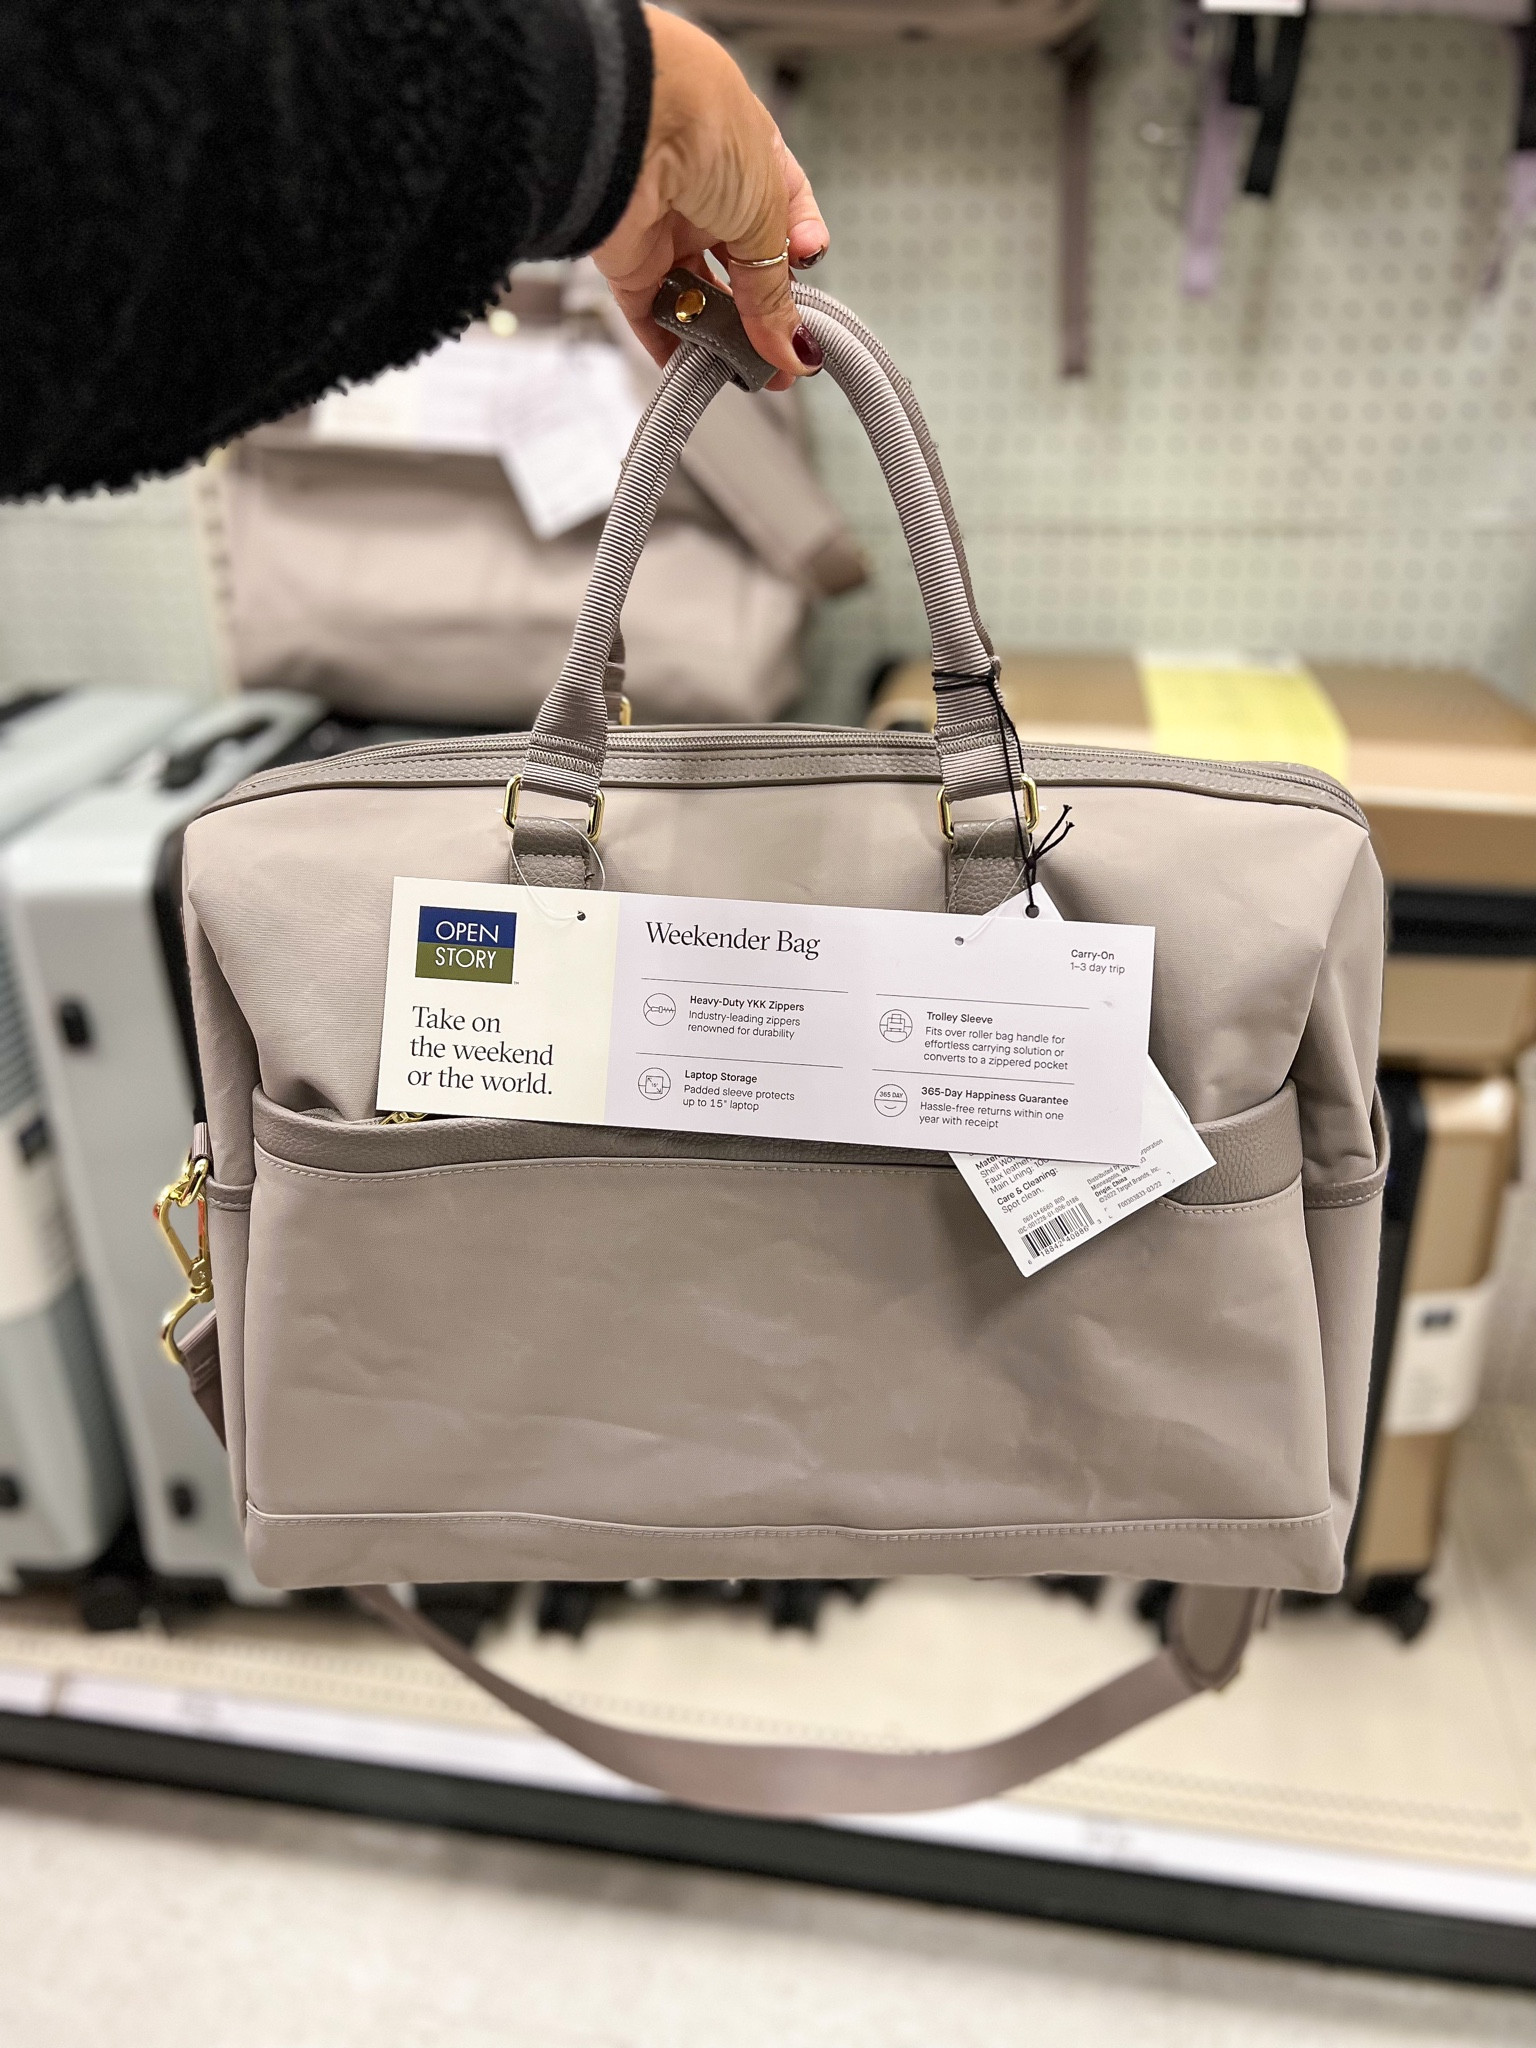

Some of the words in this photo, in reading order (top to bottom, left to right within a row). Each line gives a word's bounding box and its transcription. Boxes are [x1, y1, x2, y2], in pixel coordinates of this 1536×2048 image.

[435, 920, 499, 944] OPEN
[645, 921, 771, 951] Weekender
[775, 930, 821, 961] Bag
[435, 946, 497, 970] STORY
[1070, 949, 1115, 962] Carry-On
[1088, 963, 1107, 975] day
[1109, 964, 1126, 976] trip
[689, 995, 745, 1010] Heavy-Duty
[746, 999, 767, 1009] YKK
[768, 1000, 805, 1013] Zippers
[412, 1005, 466, 1031] Take
[471, 1016, 501, 1034] on
[688, 1010, 764, 1027] Industry-leading
[765, 1016, 801, 1028] zippers
[926, 1011, 959, 1024] Trolley
[960, 1013, 993, 1025] Sleeve
[687, 1023, 735, 1035] renowned
[737, 1025, 751, 1036] for
[752, 1027, 795, 1041] durability
[925, 1026, 943, 1036] Fits
[944, 1029, 967, 1038] over
[968, 1029, 993, 1040] roller
[995, 1030, 1014, 1044] bag
[1016, 1032, 1049, 1044] handle
[1051, 1034, 1066, 1045] for
[409, 1035, 446, 1059] the
[452, 1040, 553, 1066] weekend
[924, 1039, 970, 1051] effortless
[971, 1043, 1011, 1056] carrying
[1013, 1045, 1052, 1057] solution
[1054, 1049, 1065, 1057] or
[923, 1053, 966, 1064] converts
[968, 1055, 979, 1064] to
[980, 1057, 986, 1065] a
[988, 1056, 1032, 1068] zippered
[1033, 1060, 1069, 1070] pocket
[407, 1070, 433, 1086] or
[437, 1066, 474, 1090] the
[480, 1071, 552, 1095] world.
[684, 1069, 718, 1083] Laptop
[720, 1072, 758, 1085] Storage
[683, 1084, 721, 1096] Padded
[722, 1087, 753, 1098] sleeve
[755, 1090, 795, 1101] protects
[879, 1090, 892, 1098] 365
[891, 1091, 905, 1099] DAY
[921, 1086, 963, 1100] 365-Day
[965, 1089, 1017, 1102] Happiness
[1018, 1093, 1069, 1106] Guarantee
[682, 1098, 695, 1108] up
[697, 1098, 707, 1107] to
[710, 1098, 728, 1109] 15"
[729, 1099, 760, 1113] laptop
[920, 1101, 975, 1114] Hassle-free
[977, 1106, 1012, 1117] returns
[1013, 1109, 1043, 1119] within
[1044, 1111, 1064, 1121] one
[919, 1115, 940, 1125] year
[941, 1116, 963, 1126] with
[964, 1118, 999, 1130] receipt
[979, 1162, 1000, 1179] Shell
[984, 1172, 1004, 1187] Faux
[989, 1180, 1010, 1195] Main
[1007, 1163, 1037, 1186] Lining:
[996, 1192, 1016, 1206] Care
[1015, 1186, 1023, 1195] &
[1022, 1167, 1059, 1191] Cleaning:
[1111, 1176, 1128, 1188] China
[1115, 1180, 1133, 1193] Target
[1001, 1199, 1021, 1214] Spot
